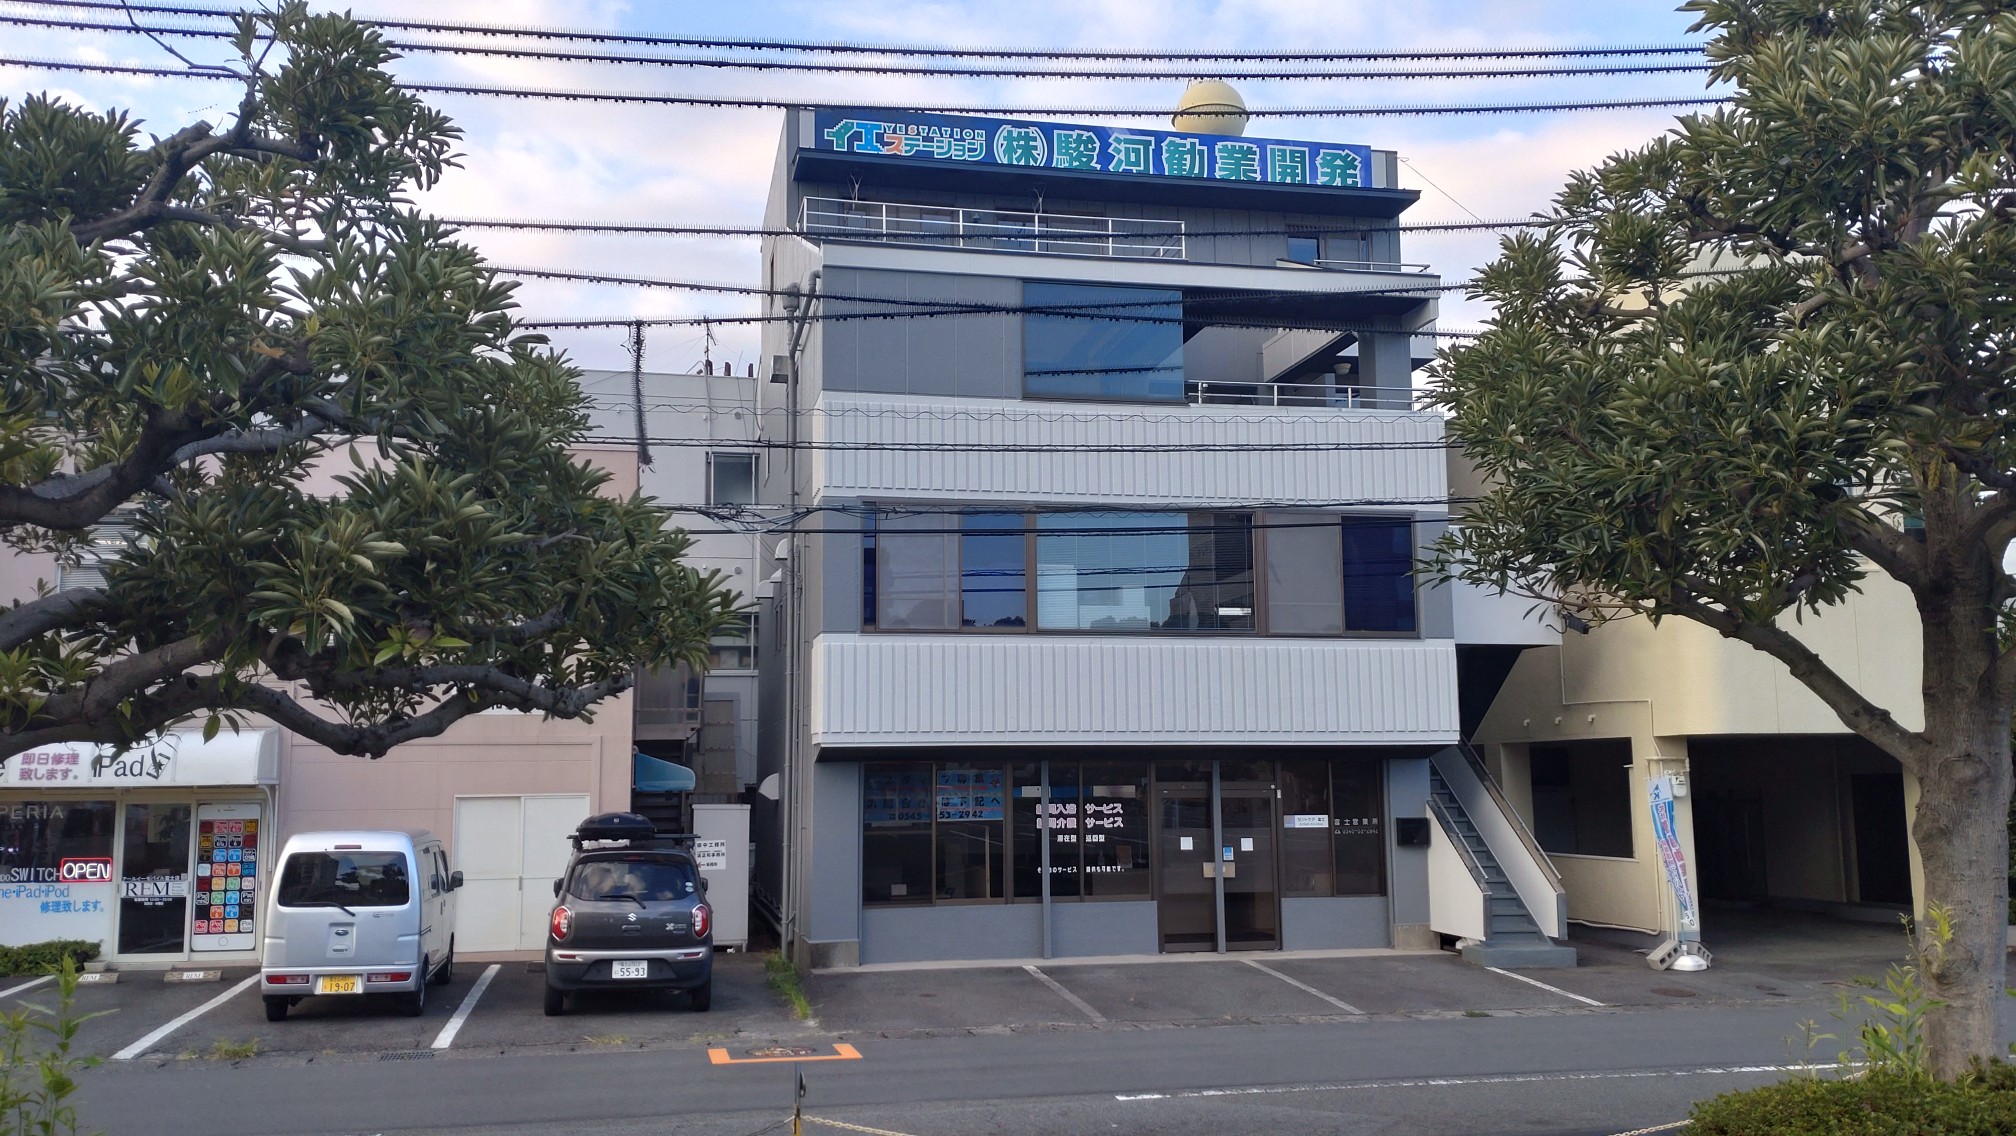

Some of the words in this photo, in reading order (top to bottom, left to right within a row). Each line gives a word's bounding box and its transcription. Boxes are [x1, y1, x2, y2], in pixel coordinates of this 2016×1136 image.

[884, 123, 986, 140] YESTATION
[21, 752, 80, 766] 即日修理
[18, 767, 79, 781] 致します。
[1085, 803, 1124, 814] サービス
[1085, 817, 1124, 828] サービス
[1334, 818, 1379, 826] 富士営業所
[63, 862, 110, 879] OPEN
[125, 882, 170, 896] REM
[40, 900, 105, 913] 修理致します。
